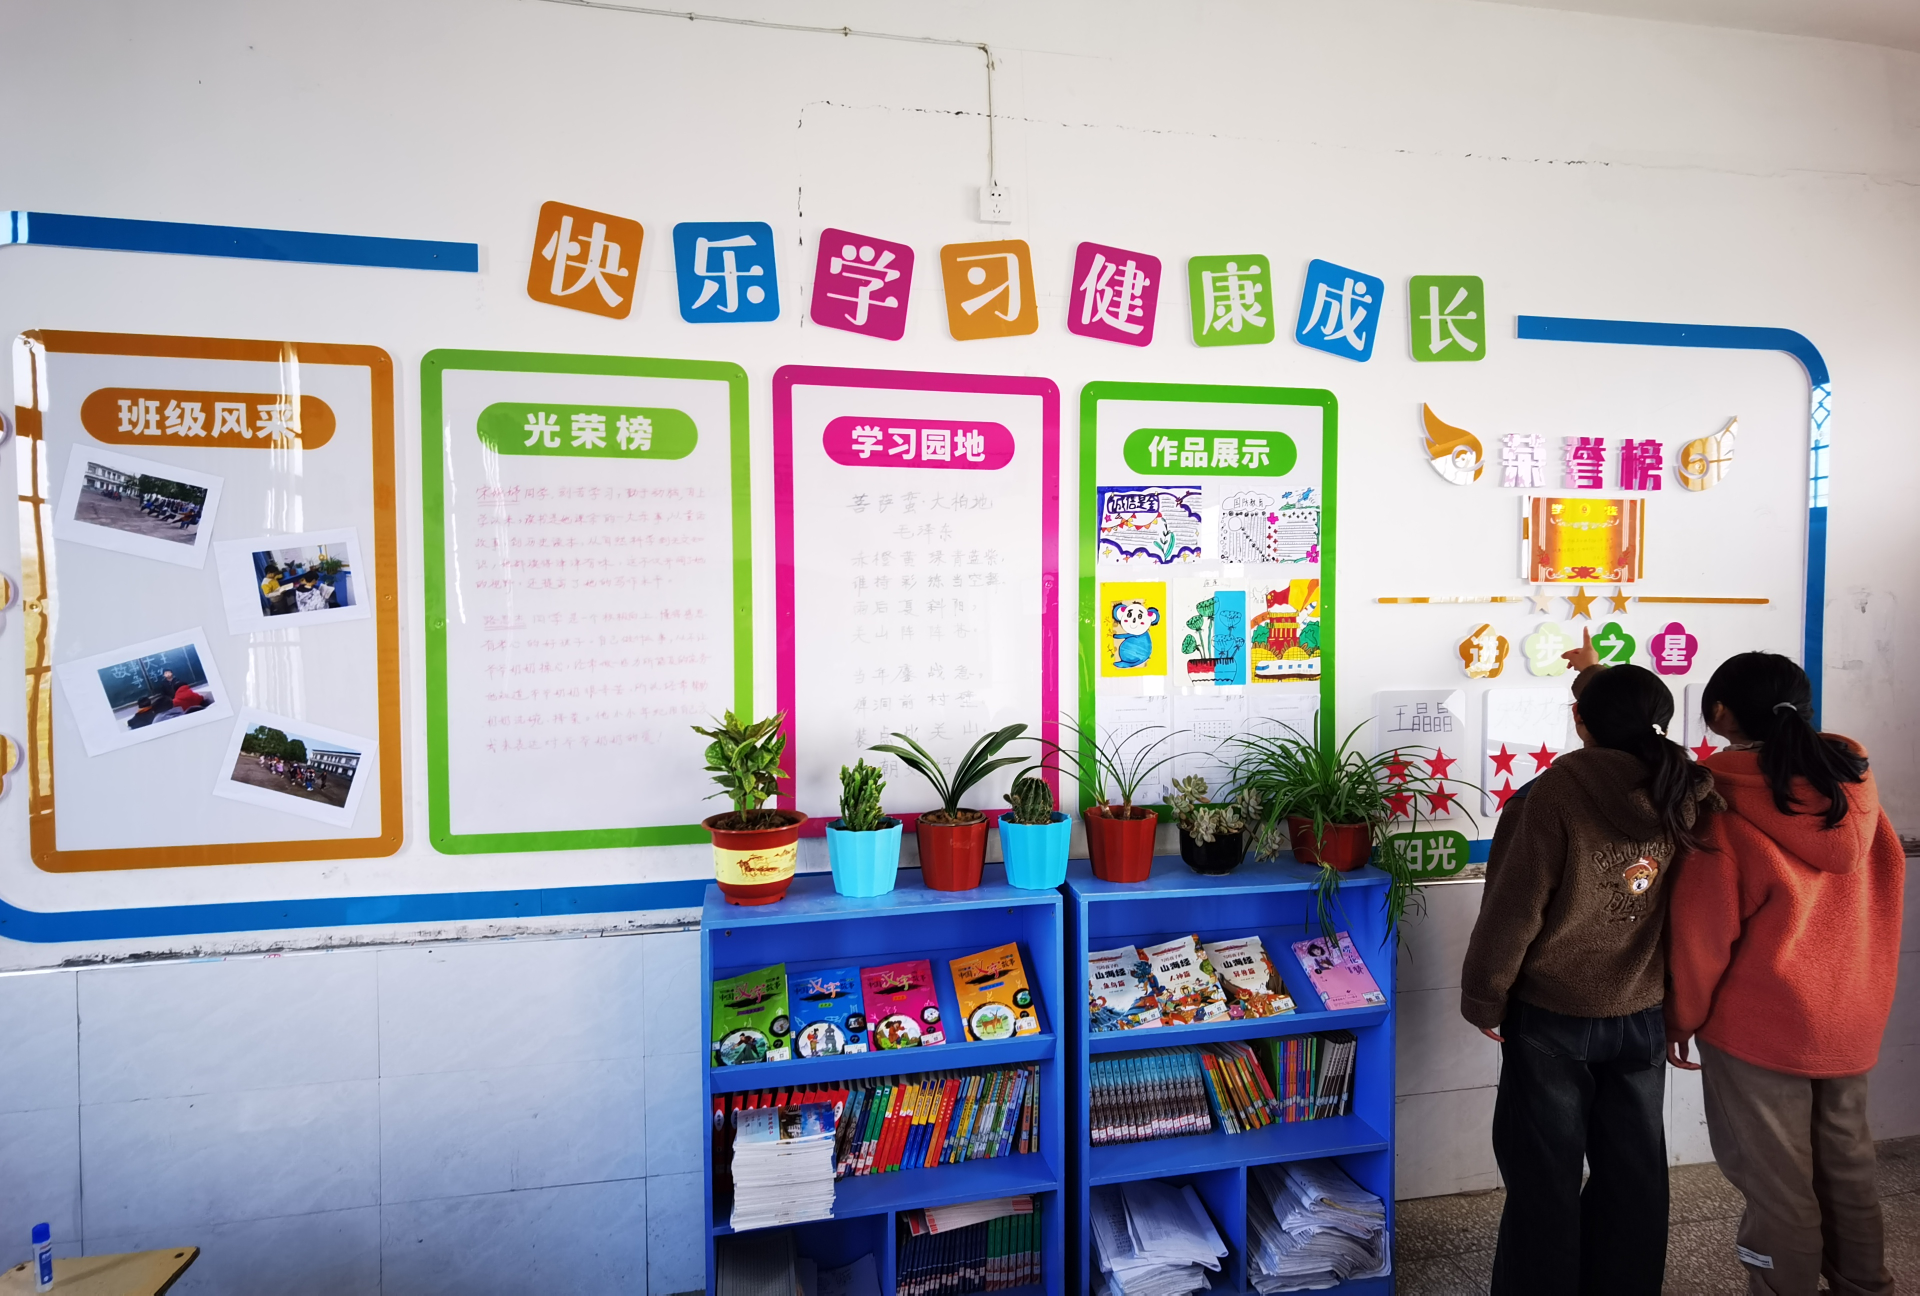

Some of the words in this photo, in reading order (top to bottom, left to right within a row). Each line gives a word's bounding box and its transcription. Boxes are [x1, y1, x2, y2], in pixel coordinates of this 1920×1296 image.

[541, 214, 1478, 354] 快乐学习健康成长
[117, 399, 301, 440] 班级风采
[523, 411, 654, 452] 光荣榜
[851, 425, 986, 462] 学习园地
[1148, 435, 1270, 469] 作品展示
[1501, 432, 1664, 491] 荣誉榜
[893, 522, 953, 544] 毛泽东
[1469, 633, 1689, 670] 进步之星
[1387, 702, 1453, 732] 王晶晶
[1394, 836, 1456, 872] 阳光
